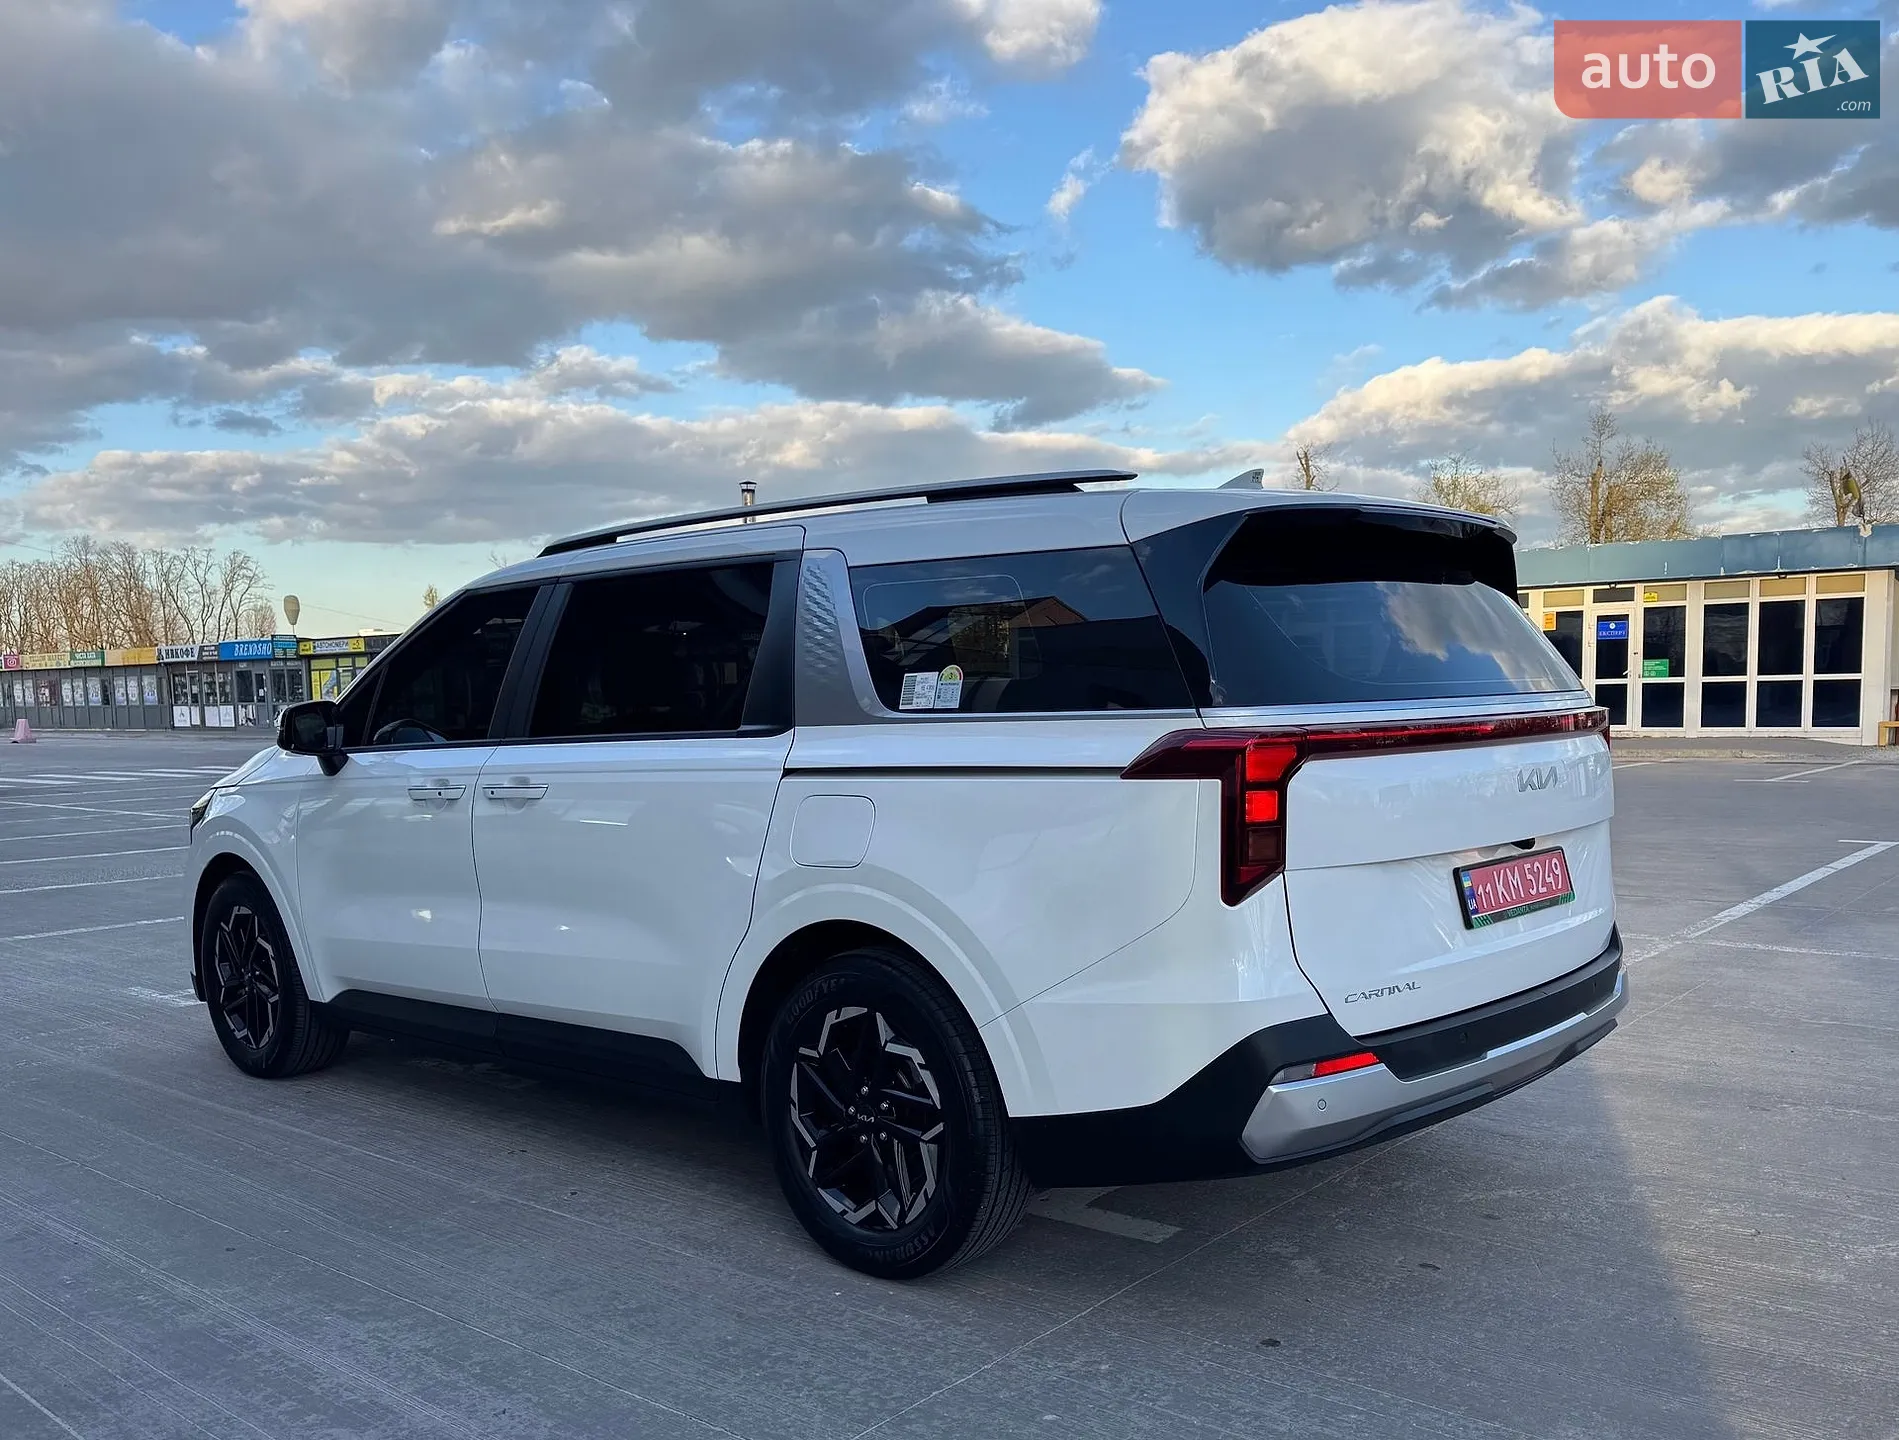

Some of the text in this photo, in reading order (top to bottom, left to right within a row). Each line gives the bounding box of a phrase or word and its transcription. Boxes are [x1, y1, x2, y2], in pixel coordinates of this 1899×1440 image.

[1517, 767, 1558, 792] KIA
[1493, 866, 1525, 904] KM
[1524, 857, 1562, 895] 5249
[1344, 981, 1421, 1004] CARNIVAL
